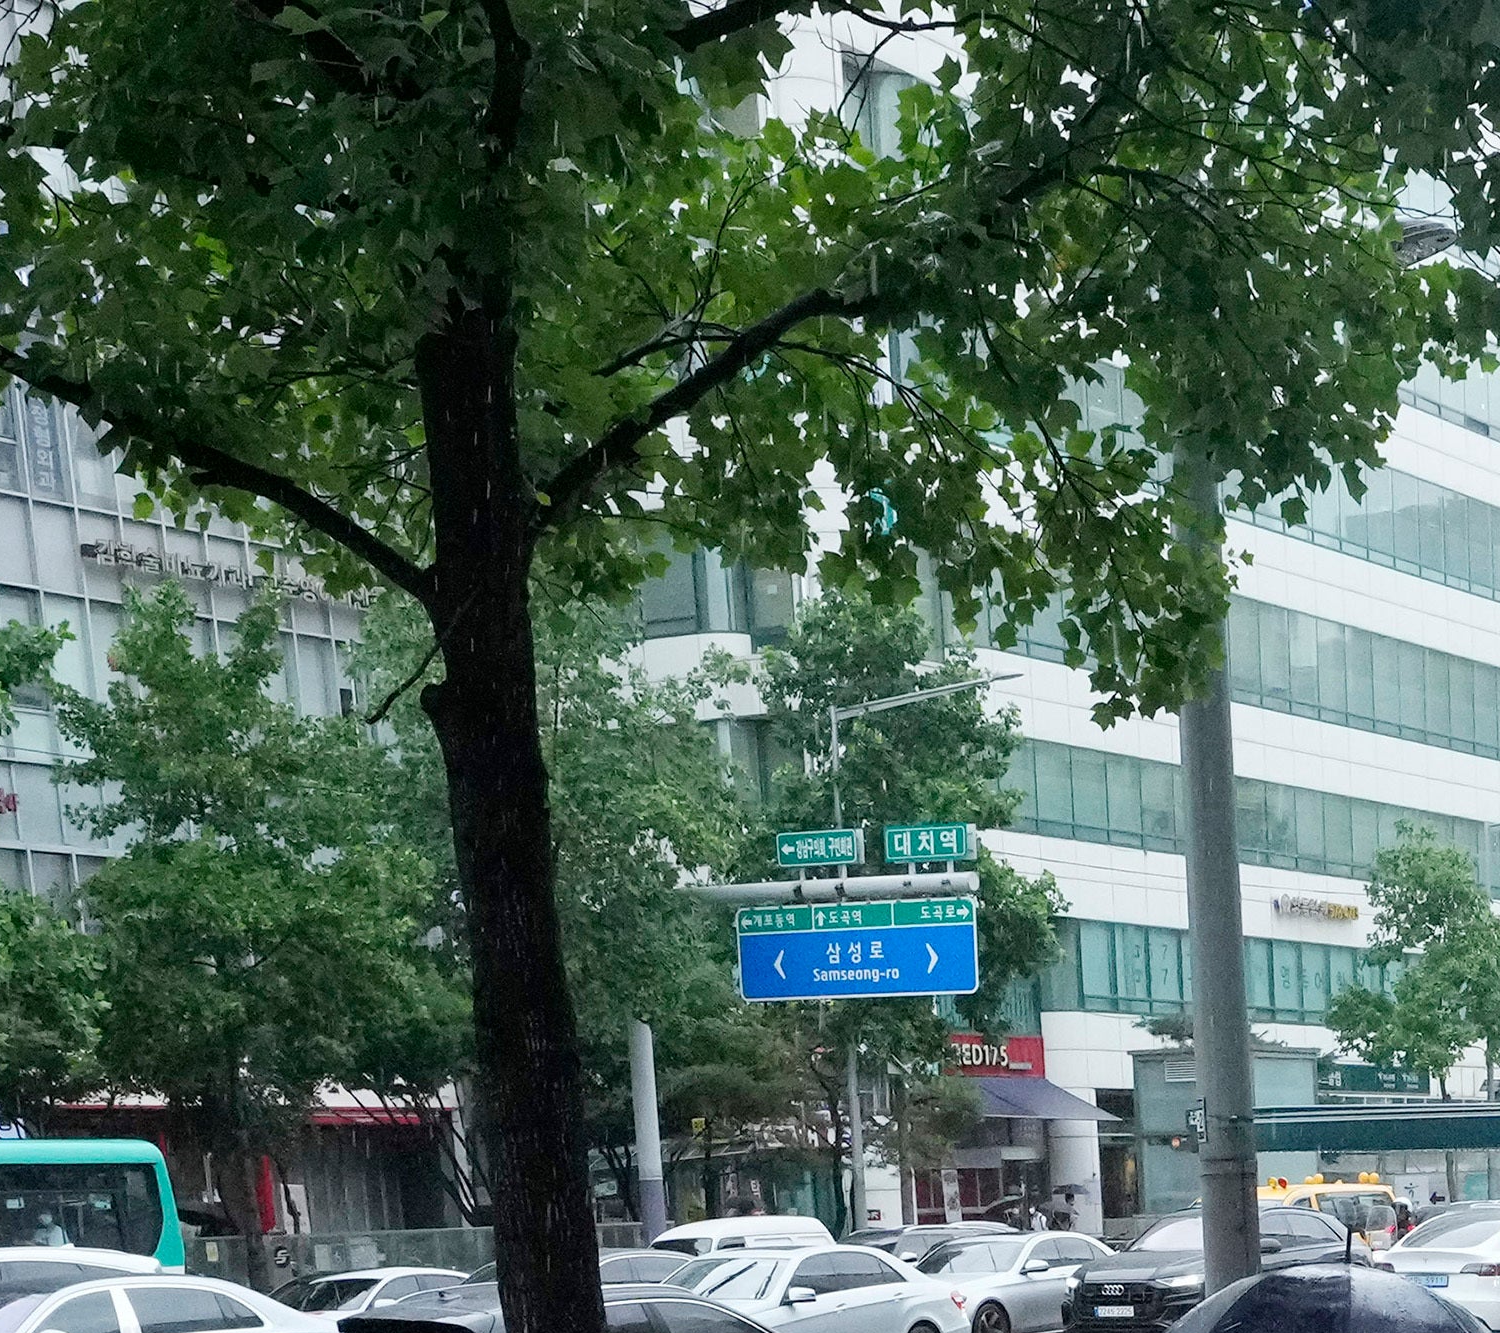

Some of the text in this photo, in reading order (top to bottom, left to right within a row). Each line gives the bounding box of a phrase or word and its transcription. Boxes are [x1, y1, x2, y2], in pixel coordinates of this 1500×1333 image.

[894, 829, 958, 856] 대치역
[752, 912, 796, 928] 개포동역
[828, 909, 863, 925] 도곡역
[920, 905, 957, 920] 도곡로
[826, 940, 885, 965] 삼성로
[813, 968, 900, 983] Samseong-ro
